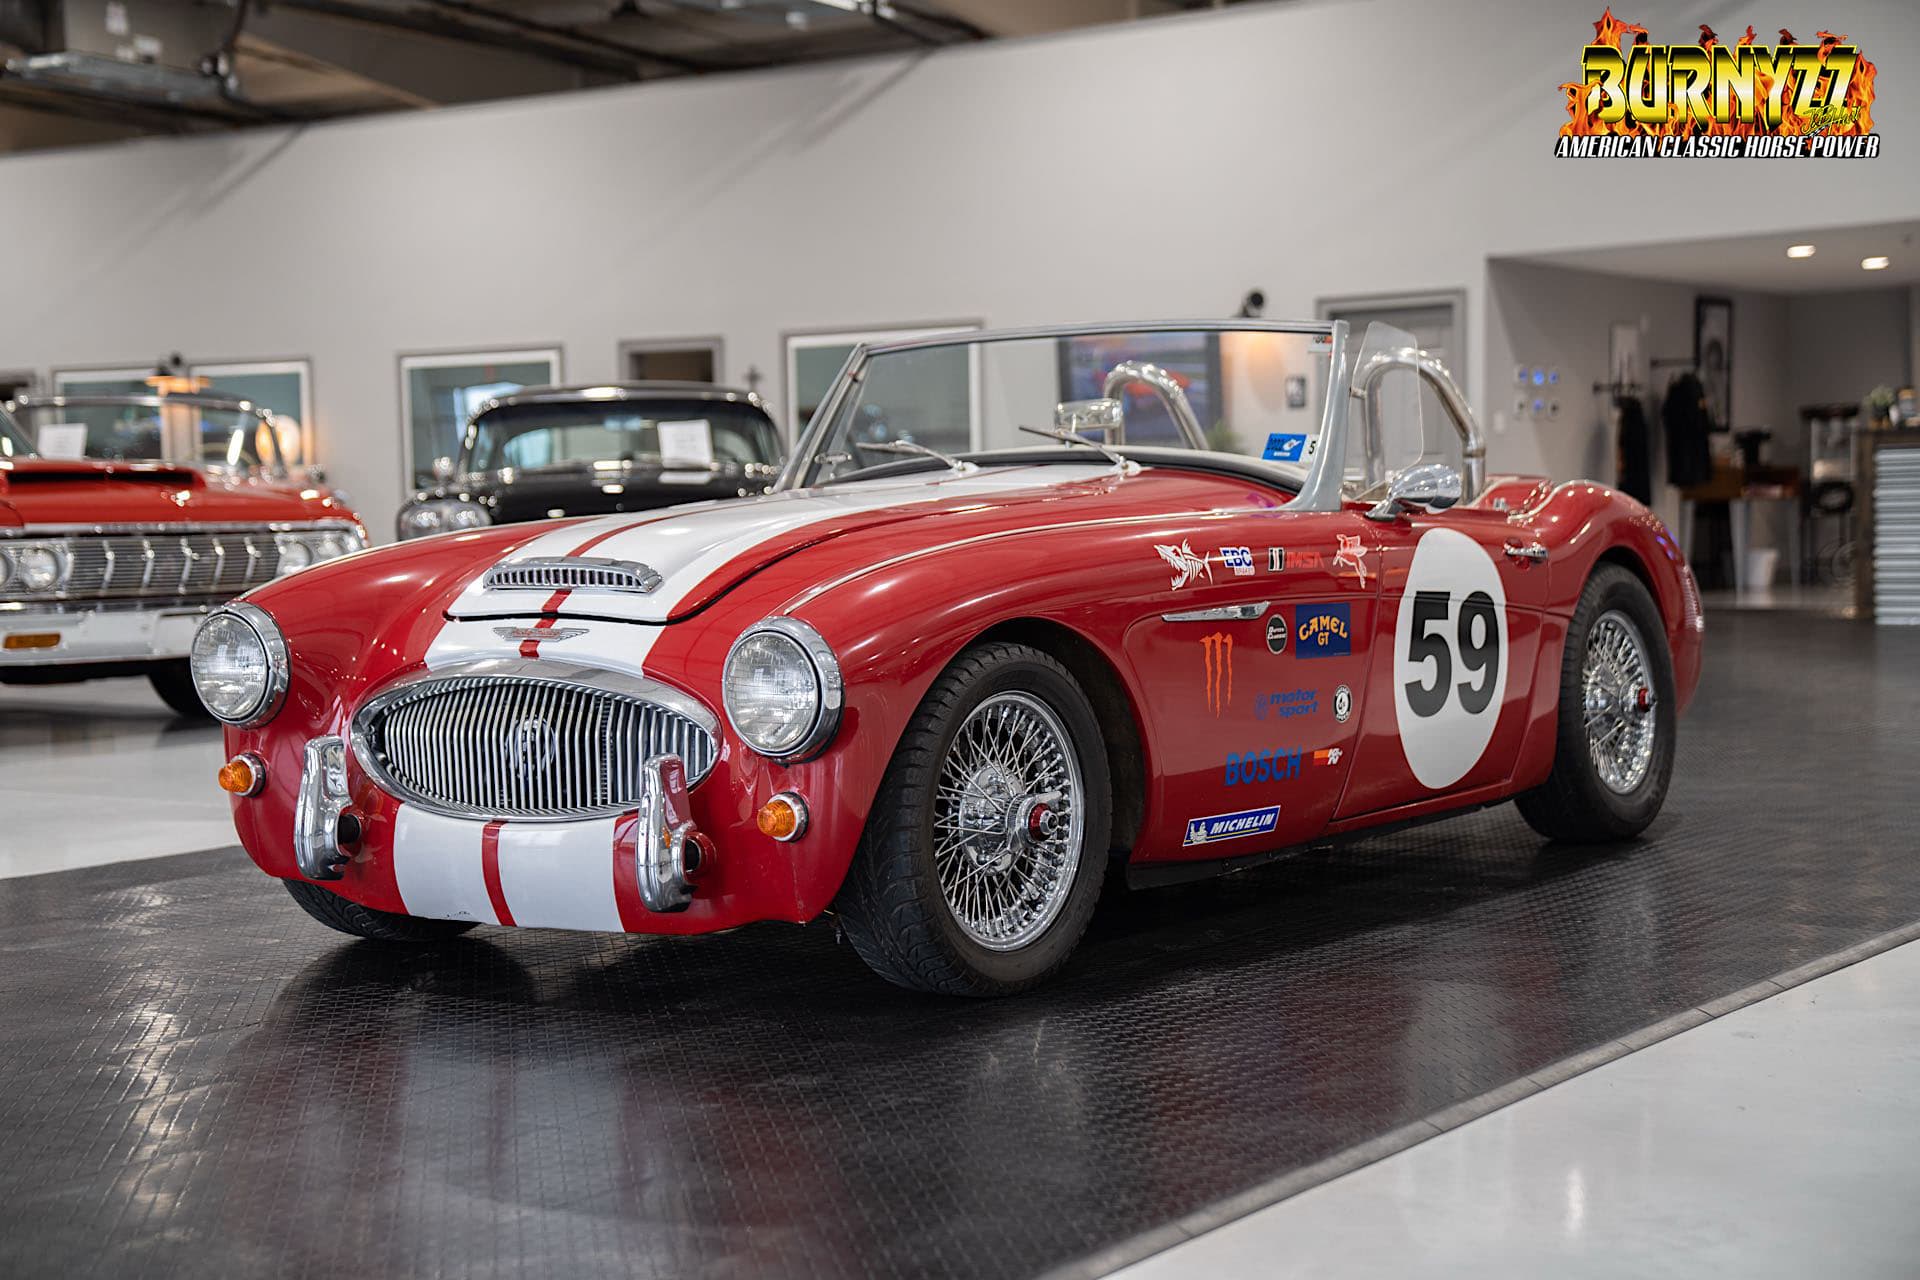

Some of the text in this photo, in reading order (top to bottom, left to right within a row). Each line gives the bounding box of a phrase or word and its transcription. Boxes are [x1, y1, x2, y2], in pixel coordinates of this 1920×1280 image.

[1222, 549, 1252, 567] EBC
[1299, 616, 1348, 640] CAMEL
[1317, 632, 1329, 646] GT
[1405, 591, 1499, 718] 59
[1270, 689, 1317, 704] motor
[1279, 701, 1318, 717] sport
[1225, 745, 1302, 786] BOSCH
[1210, 813, 1275, 834] MICHELIN
